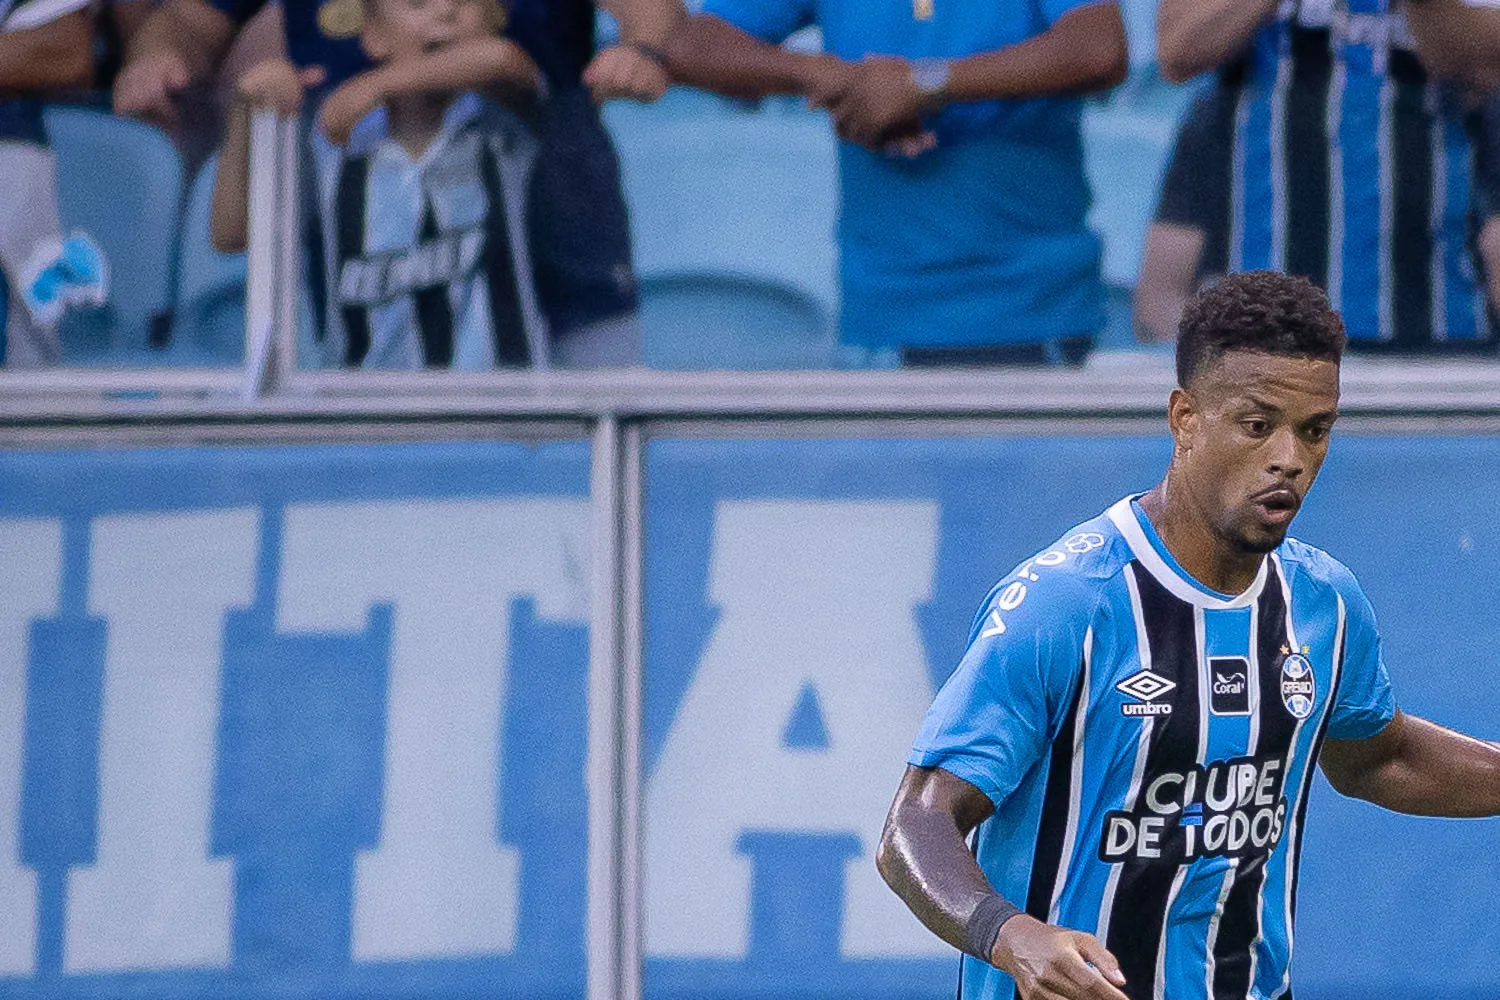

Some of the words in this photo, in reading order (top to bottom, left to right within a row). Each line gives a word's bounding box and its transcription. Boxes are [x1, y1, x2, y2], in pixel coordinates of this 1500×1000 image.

[981, 551, 1066, 639] vero
[1123, 703, 1172, 715] umbro
[1213, 681, 1241, 695] Coral
[1145, 760, 1280, 814] CLUBE
[1105, 817, 1165, 858] DE
[1179, 804, 1285, 857] TODOS
